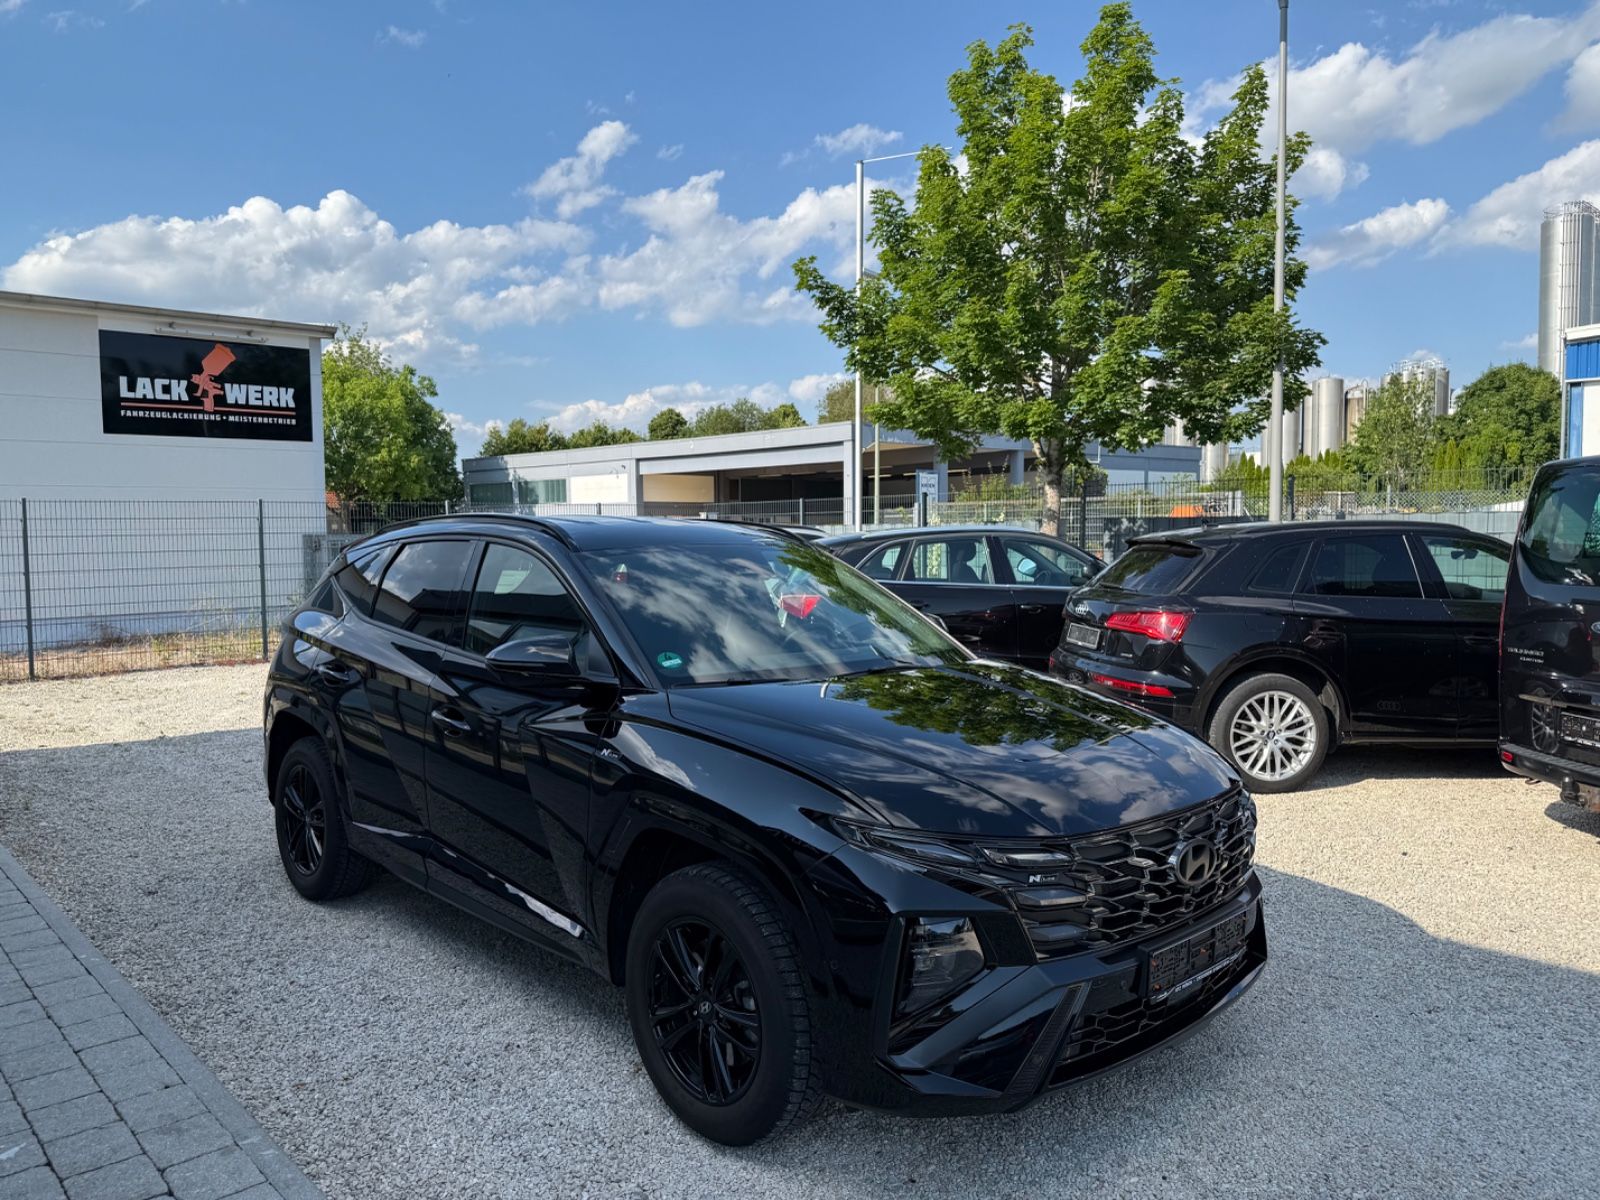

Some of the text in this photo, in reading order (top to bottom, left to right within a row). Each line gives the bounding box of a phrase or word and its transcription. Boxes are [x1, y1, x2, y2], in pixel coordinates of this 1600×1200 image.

[119, 375, 296, 408] LACK WERK
[120, 409, 297, 426] FAHRZEUGLACKIERUNG MEISTERBETRIEB
